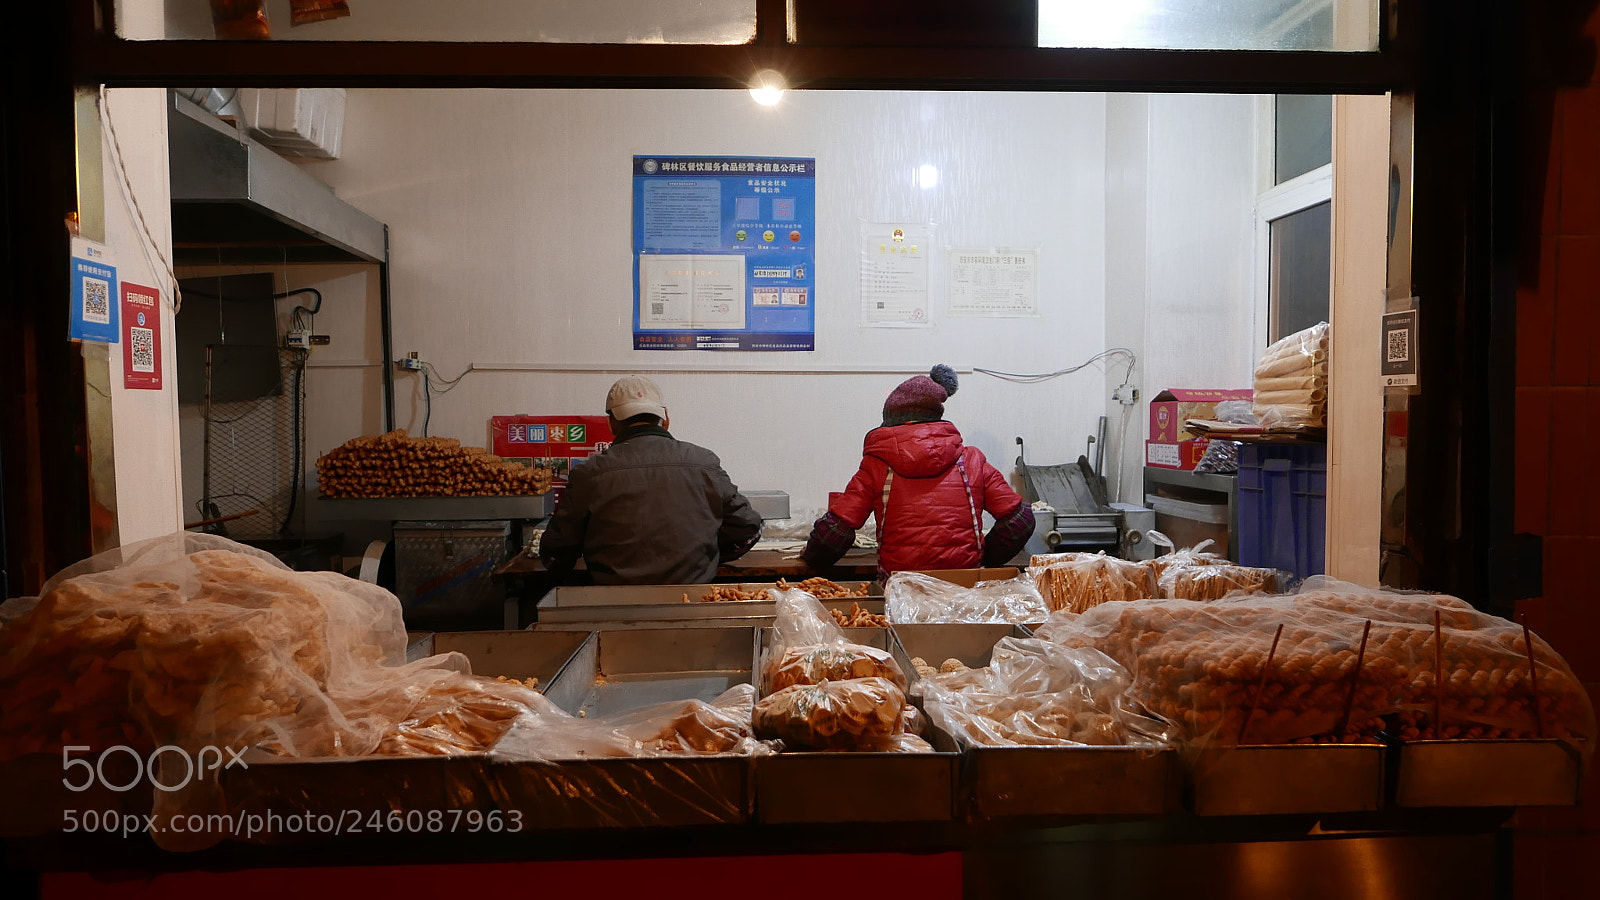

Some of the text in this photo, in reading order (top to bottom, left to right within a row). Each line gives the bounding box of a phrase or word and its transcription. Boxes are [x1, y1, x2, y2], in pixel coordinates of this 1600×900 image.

[661, 162, 806, 174] 碑林区餐饮服务食品经营者信息公示栏
[126, 291, 155, 306] 扫码领红包
[509, 425, 585, 442] 美丽枣乡
